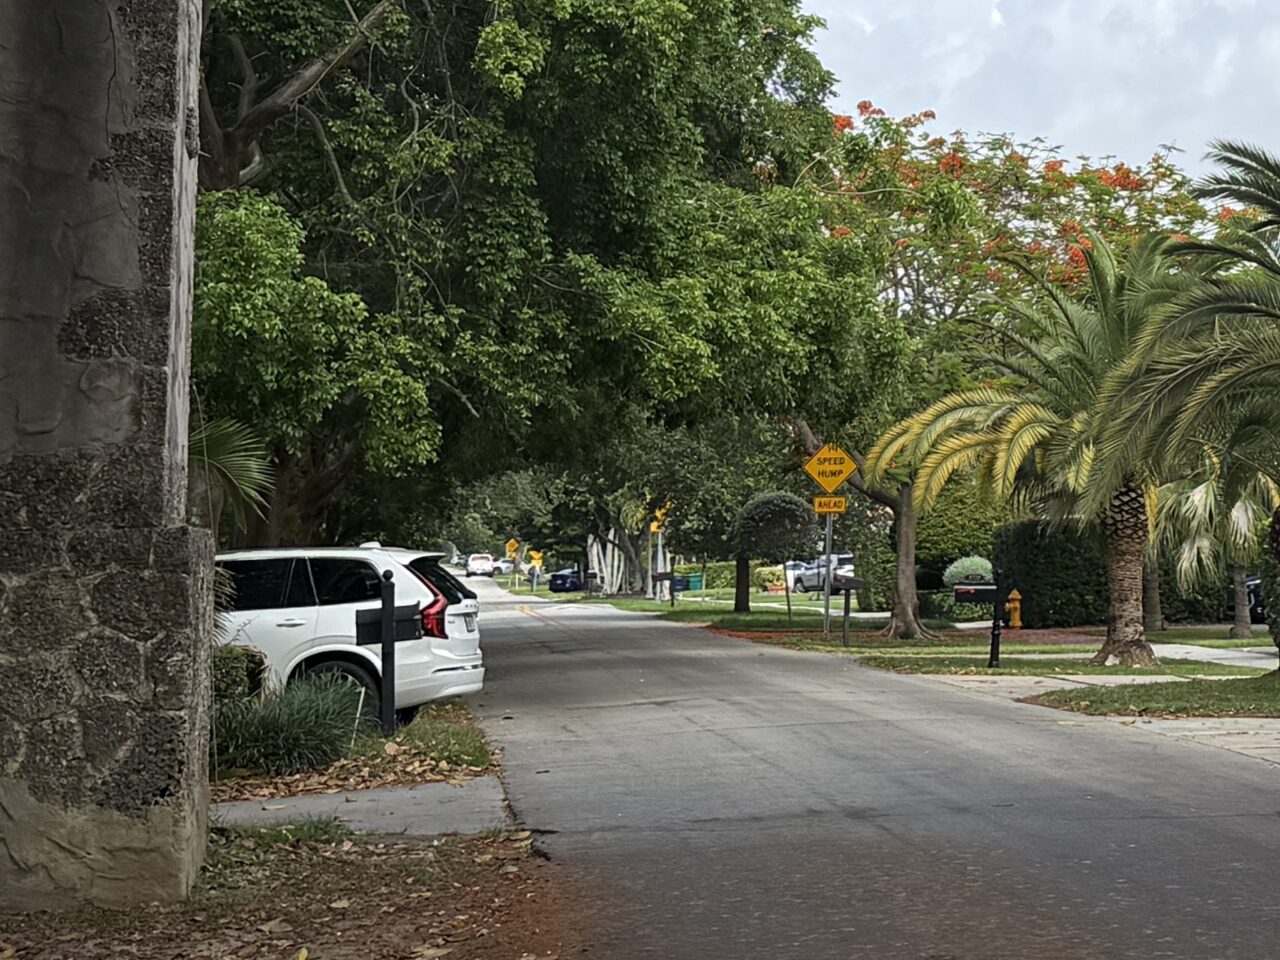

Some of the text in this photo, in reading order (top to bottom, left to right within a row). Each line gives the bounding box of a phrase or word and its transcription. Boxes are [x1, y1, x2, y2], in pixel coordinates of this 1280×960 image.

[816, 456, 845, 465] SPEED
[817, 470, 843, 478] HUMP
[818, 500, 843, 508] AHEAD
